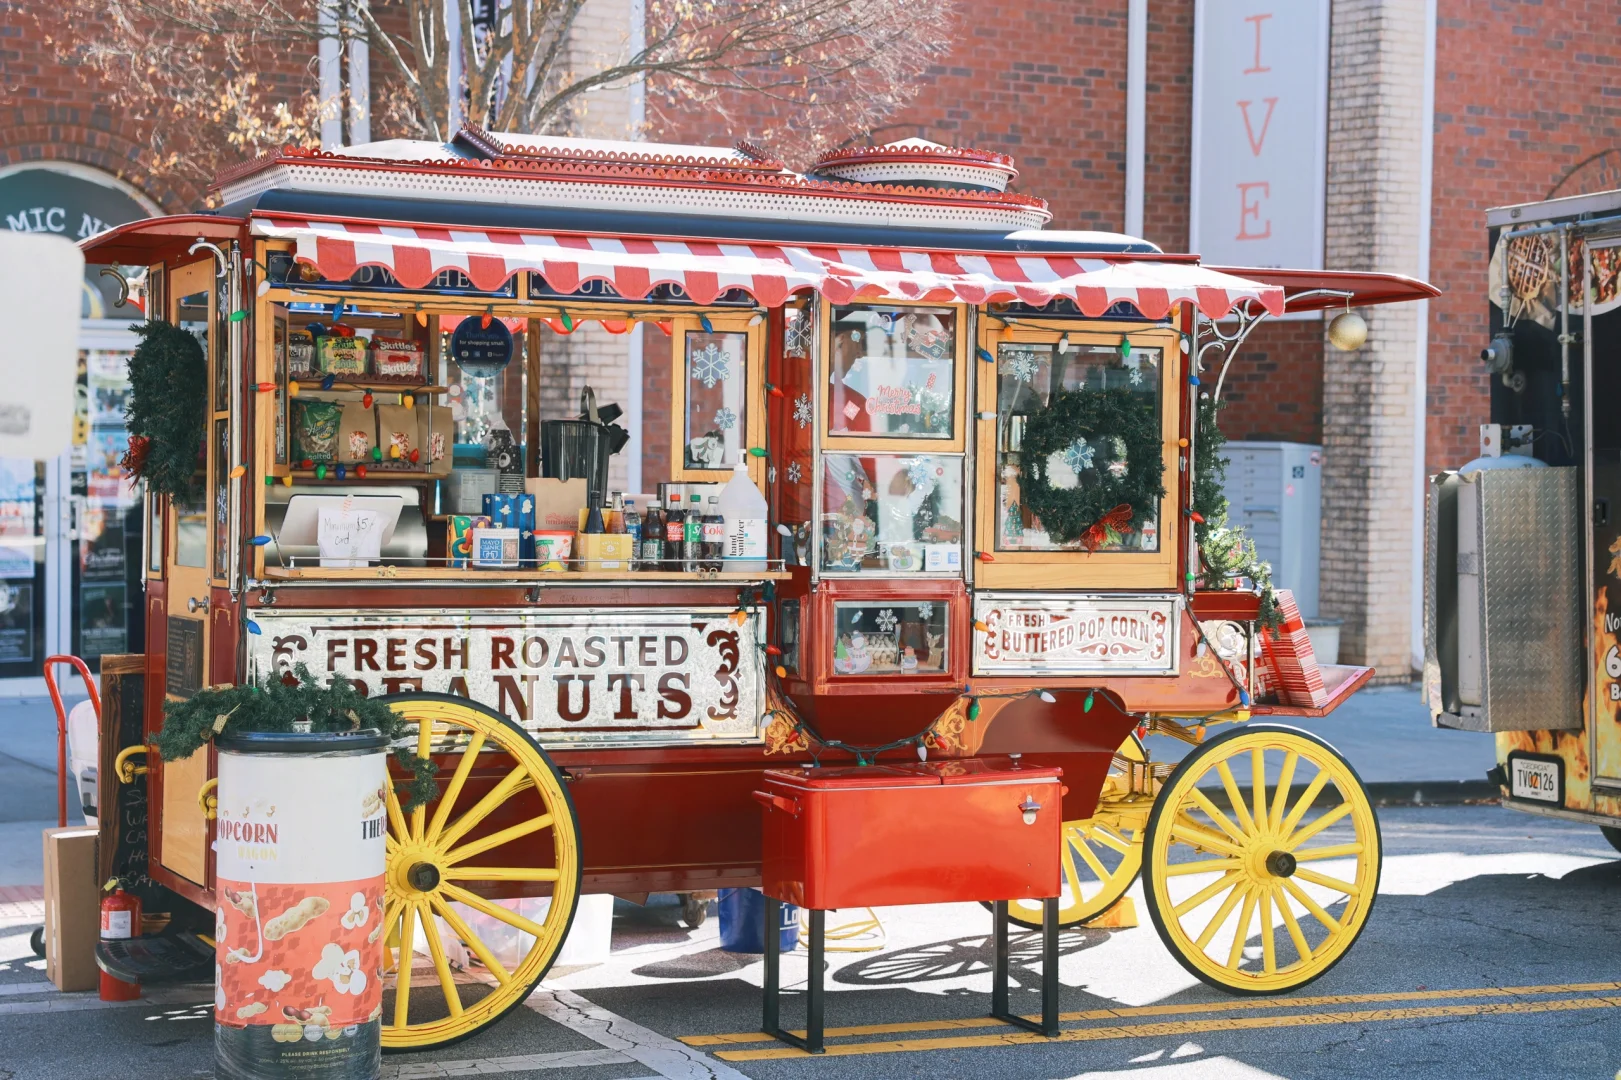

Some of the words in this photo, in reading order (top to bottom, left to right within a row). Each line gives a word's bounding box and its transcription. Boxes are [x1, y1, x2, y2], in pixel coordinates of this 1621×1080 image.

[380, 341, 416, 351] Skittles
[381, 362, 417, 374] Skittles
[878, 385, 912, 403] Merry
[865, 396, 921, 415] Christmas
[1008, 614, 1045, 627] FRESH
[1002, 624, 1075, 653] BUTTERED
[1111, 615, 1149, 643] CORN
[327, 637, 469, 672] FRESH
[490, 635, 690, 670] ROASTED
[326, 672, 693, 722] NUTS
